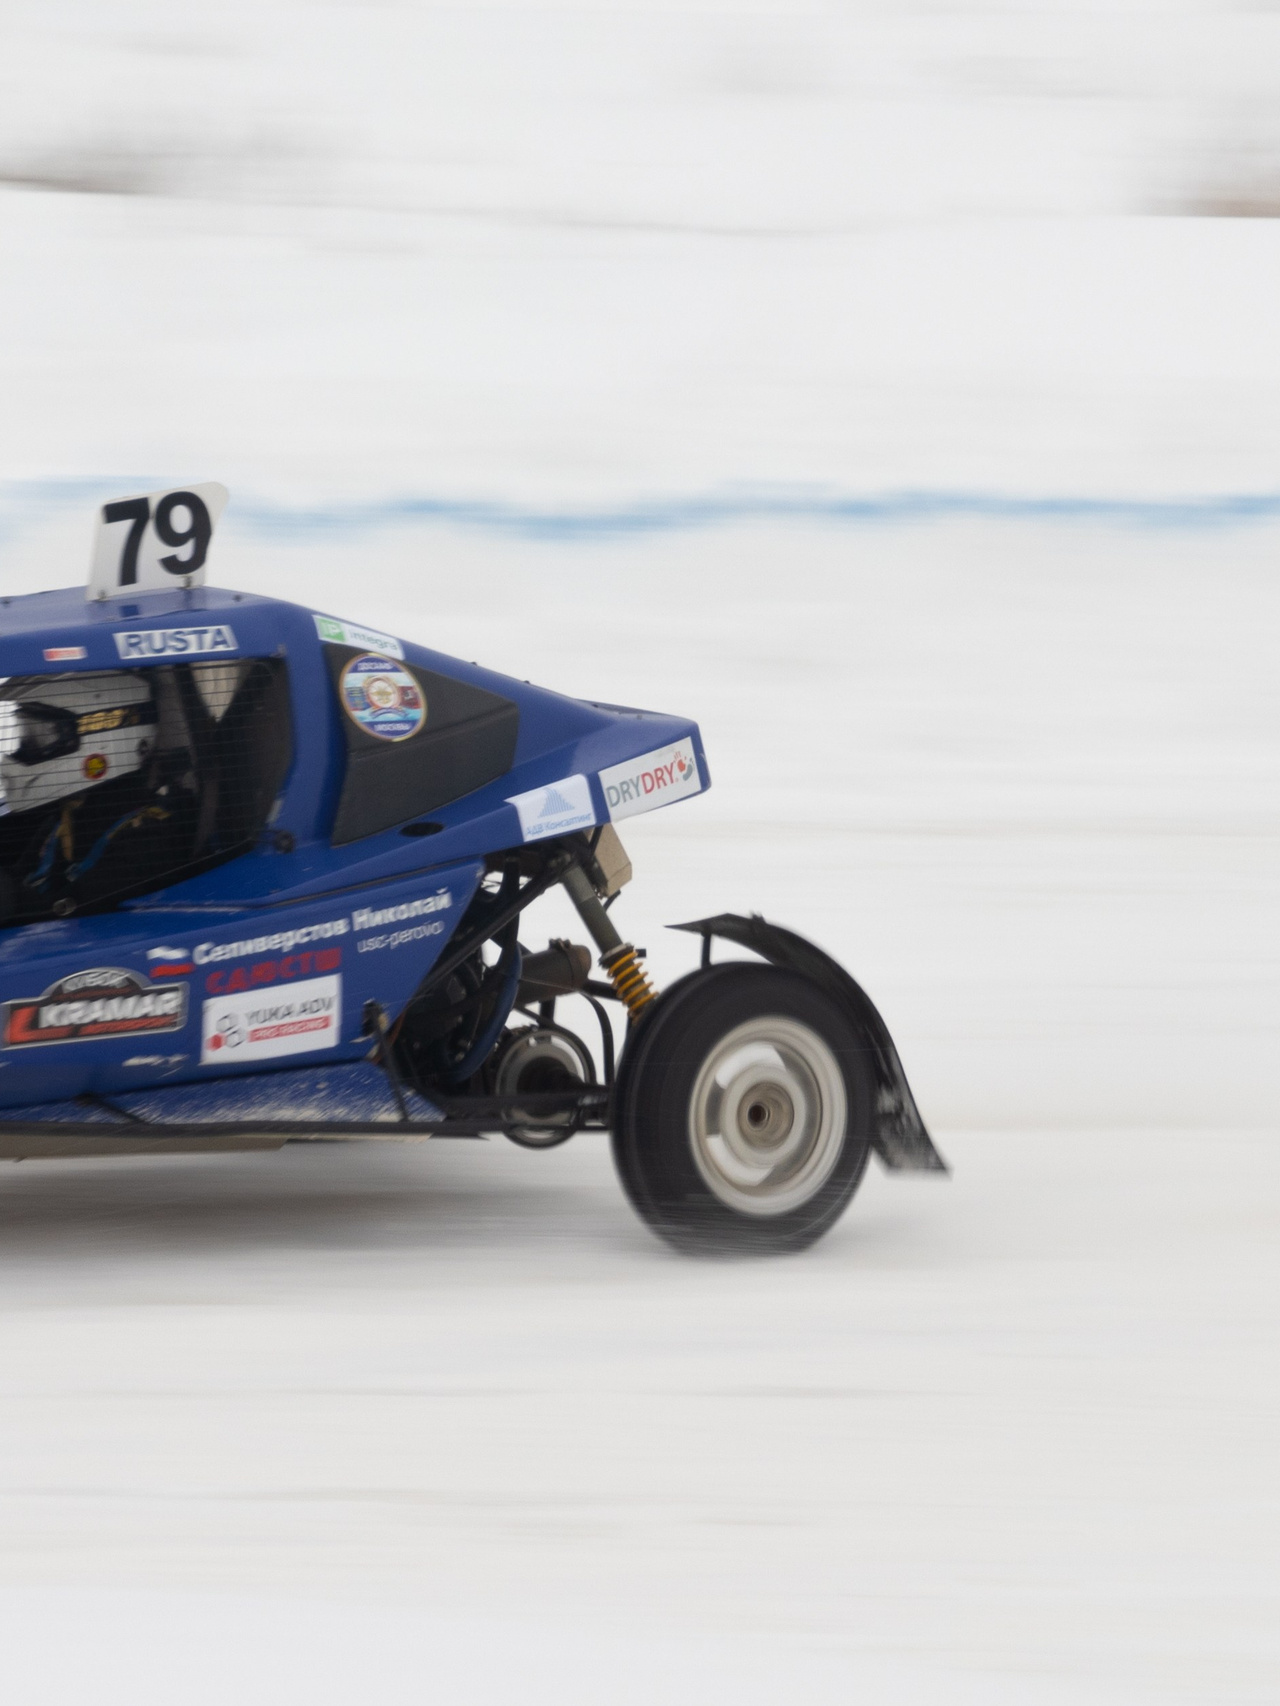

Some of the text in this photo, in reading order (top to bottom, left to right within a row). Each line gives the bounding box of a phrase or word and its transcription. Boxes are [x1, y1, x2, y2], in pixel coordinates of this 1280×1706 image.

[103, 491, 212, 587] 79
[125, 628, 232, 656] RUSTA
[193, 887, 453, 964] Селиверстов Николай
[357, 920, 445, 953] usc-perovo
[38, 990, 182, 1028] KRAMAR
